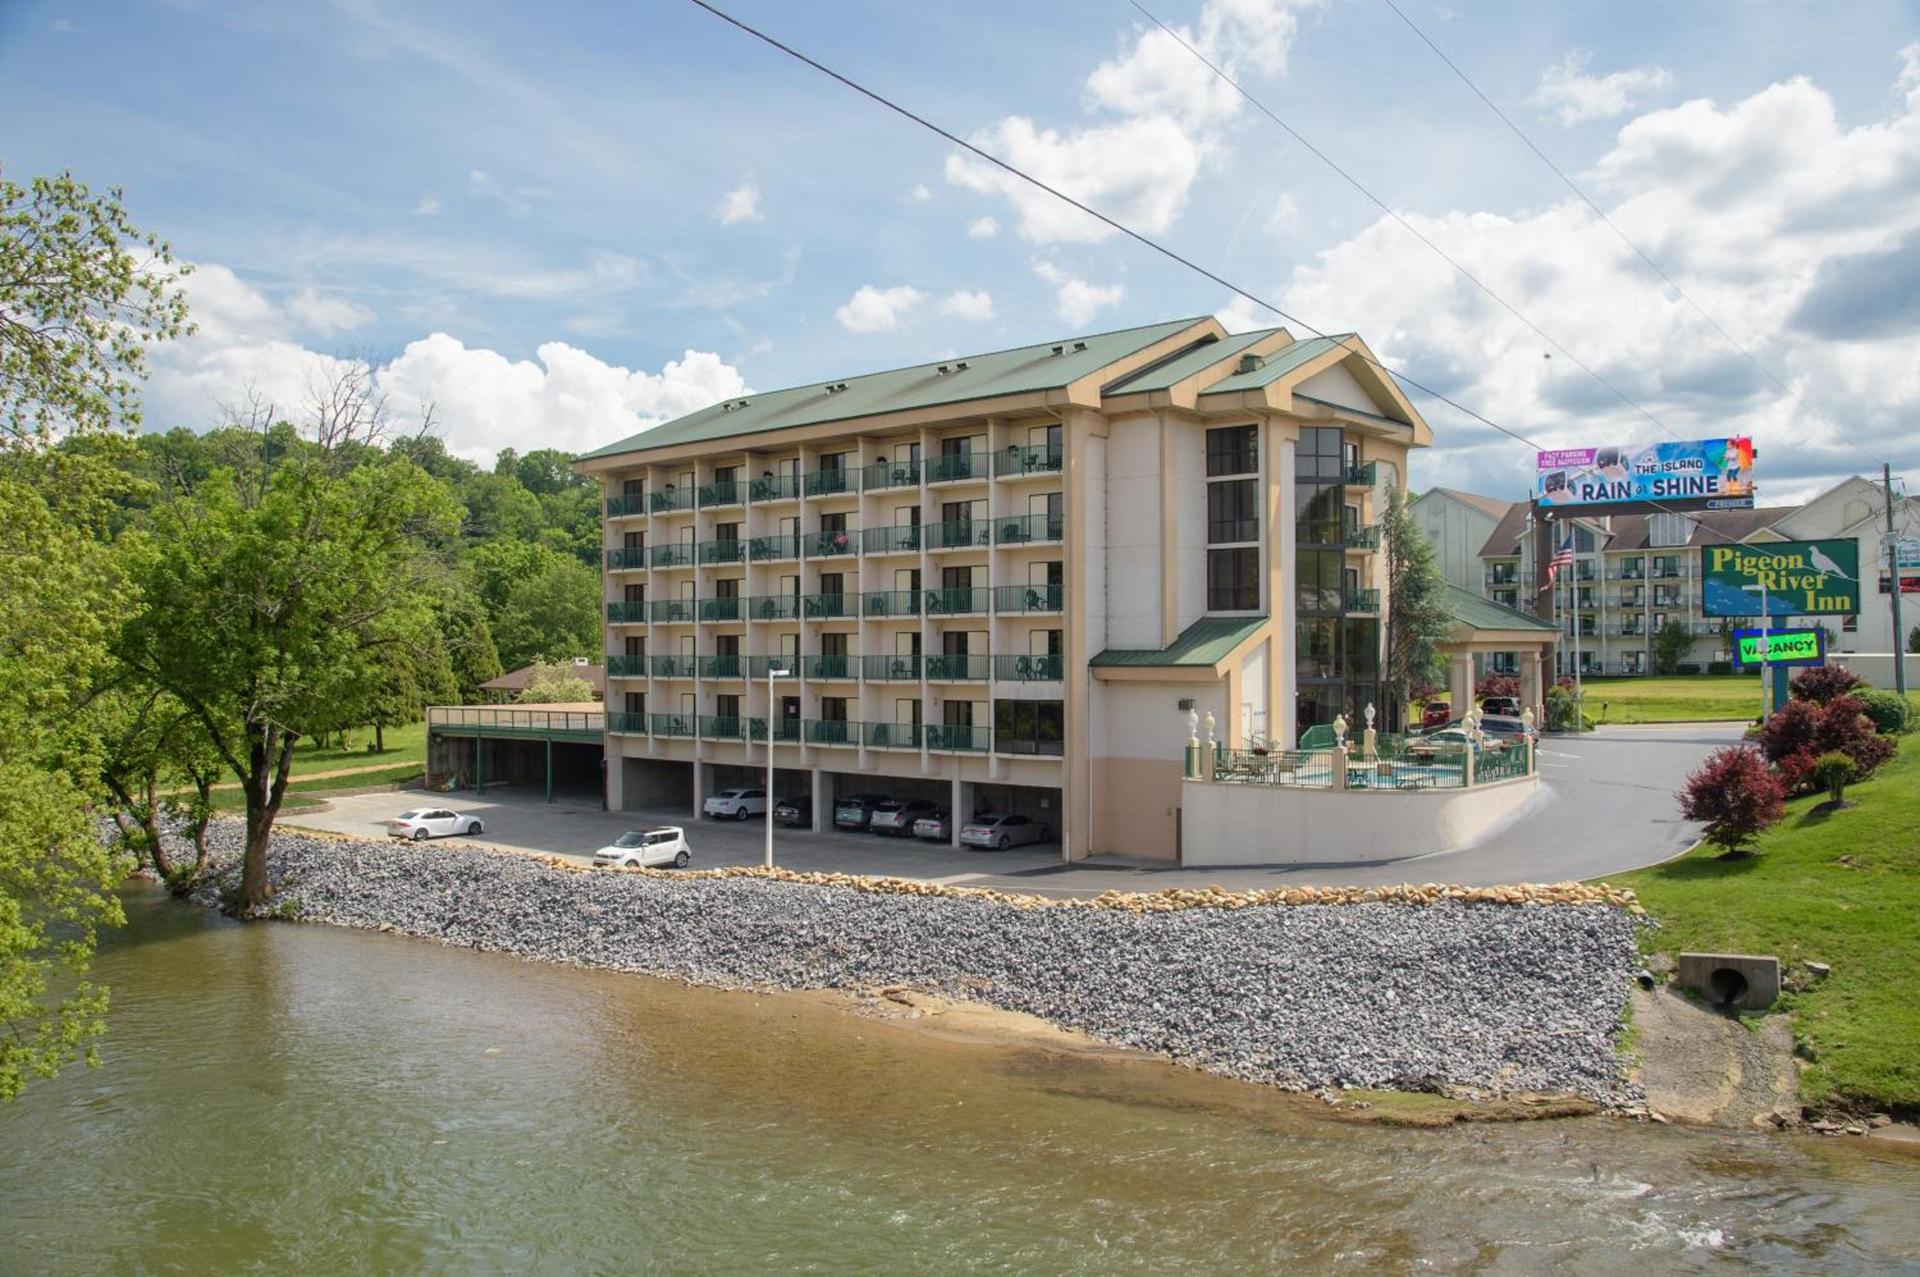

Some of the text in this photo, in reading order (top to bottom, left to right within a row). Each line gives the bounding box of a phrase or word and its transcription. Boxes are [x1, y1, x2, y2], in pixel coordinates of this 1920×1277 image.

[1635, 459, 1703, 474] THE ISLAND
[1582, 481, 1631, 500] RAIN
[1653, 476, 1718, 496] SHINE
[1712, 548, 1804, 576] Pigeon
[1757, 570, 1829, 590] River
[1805, 591, 1850, 611] Inn
